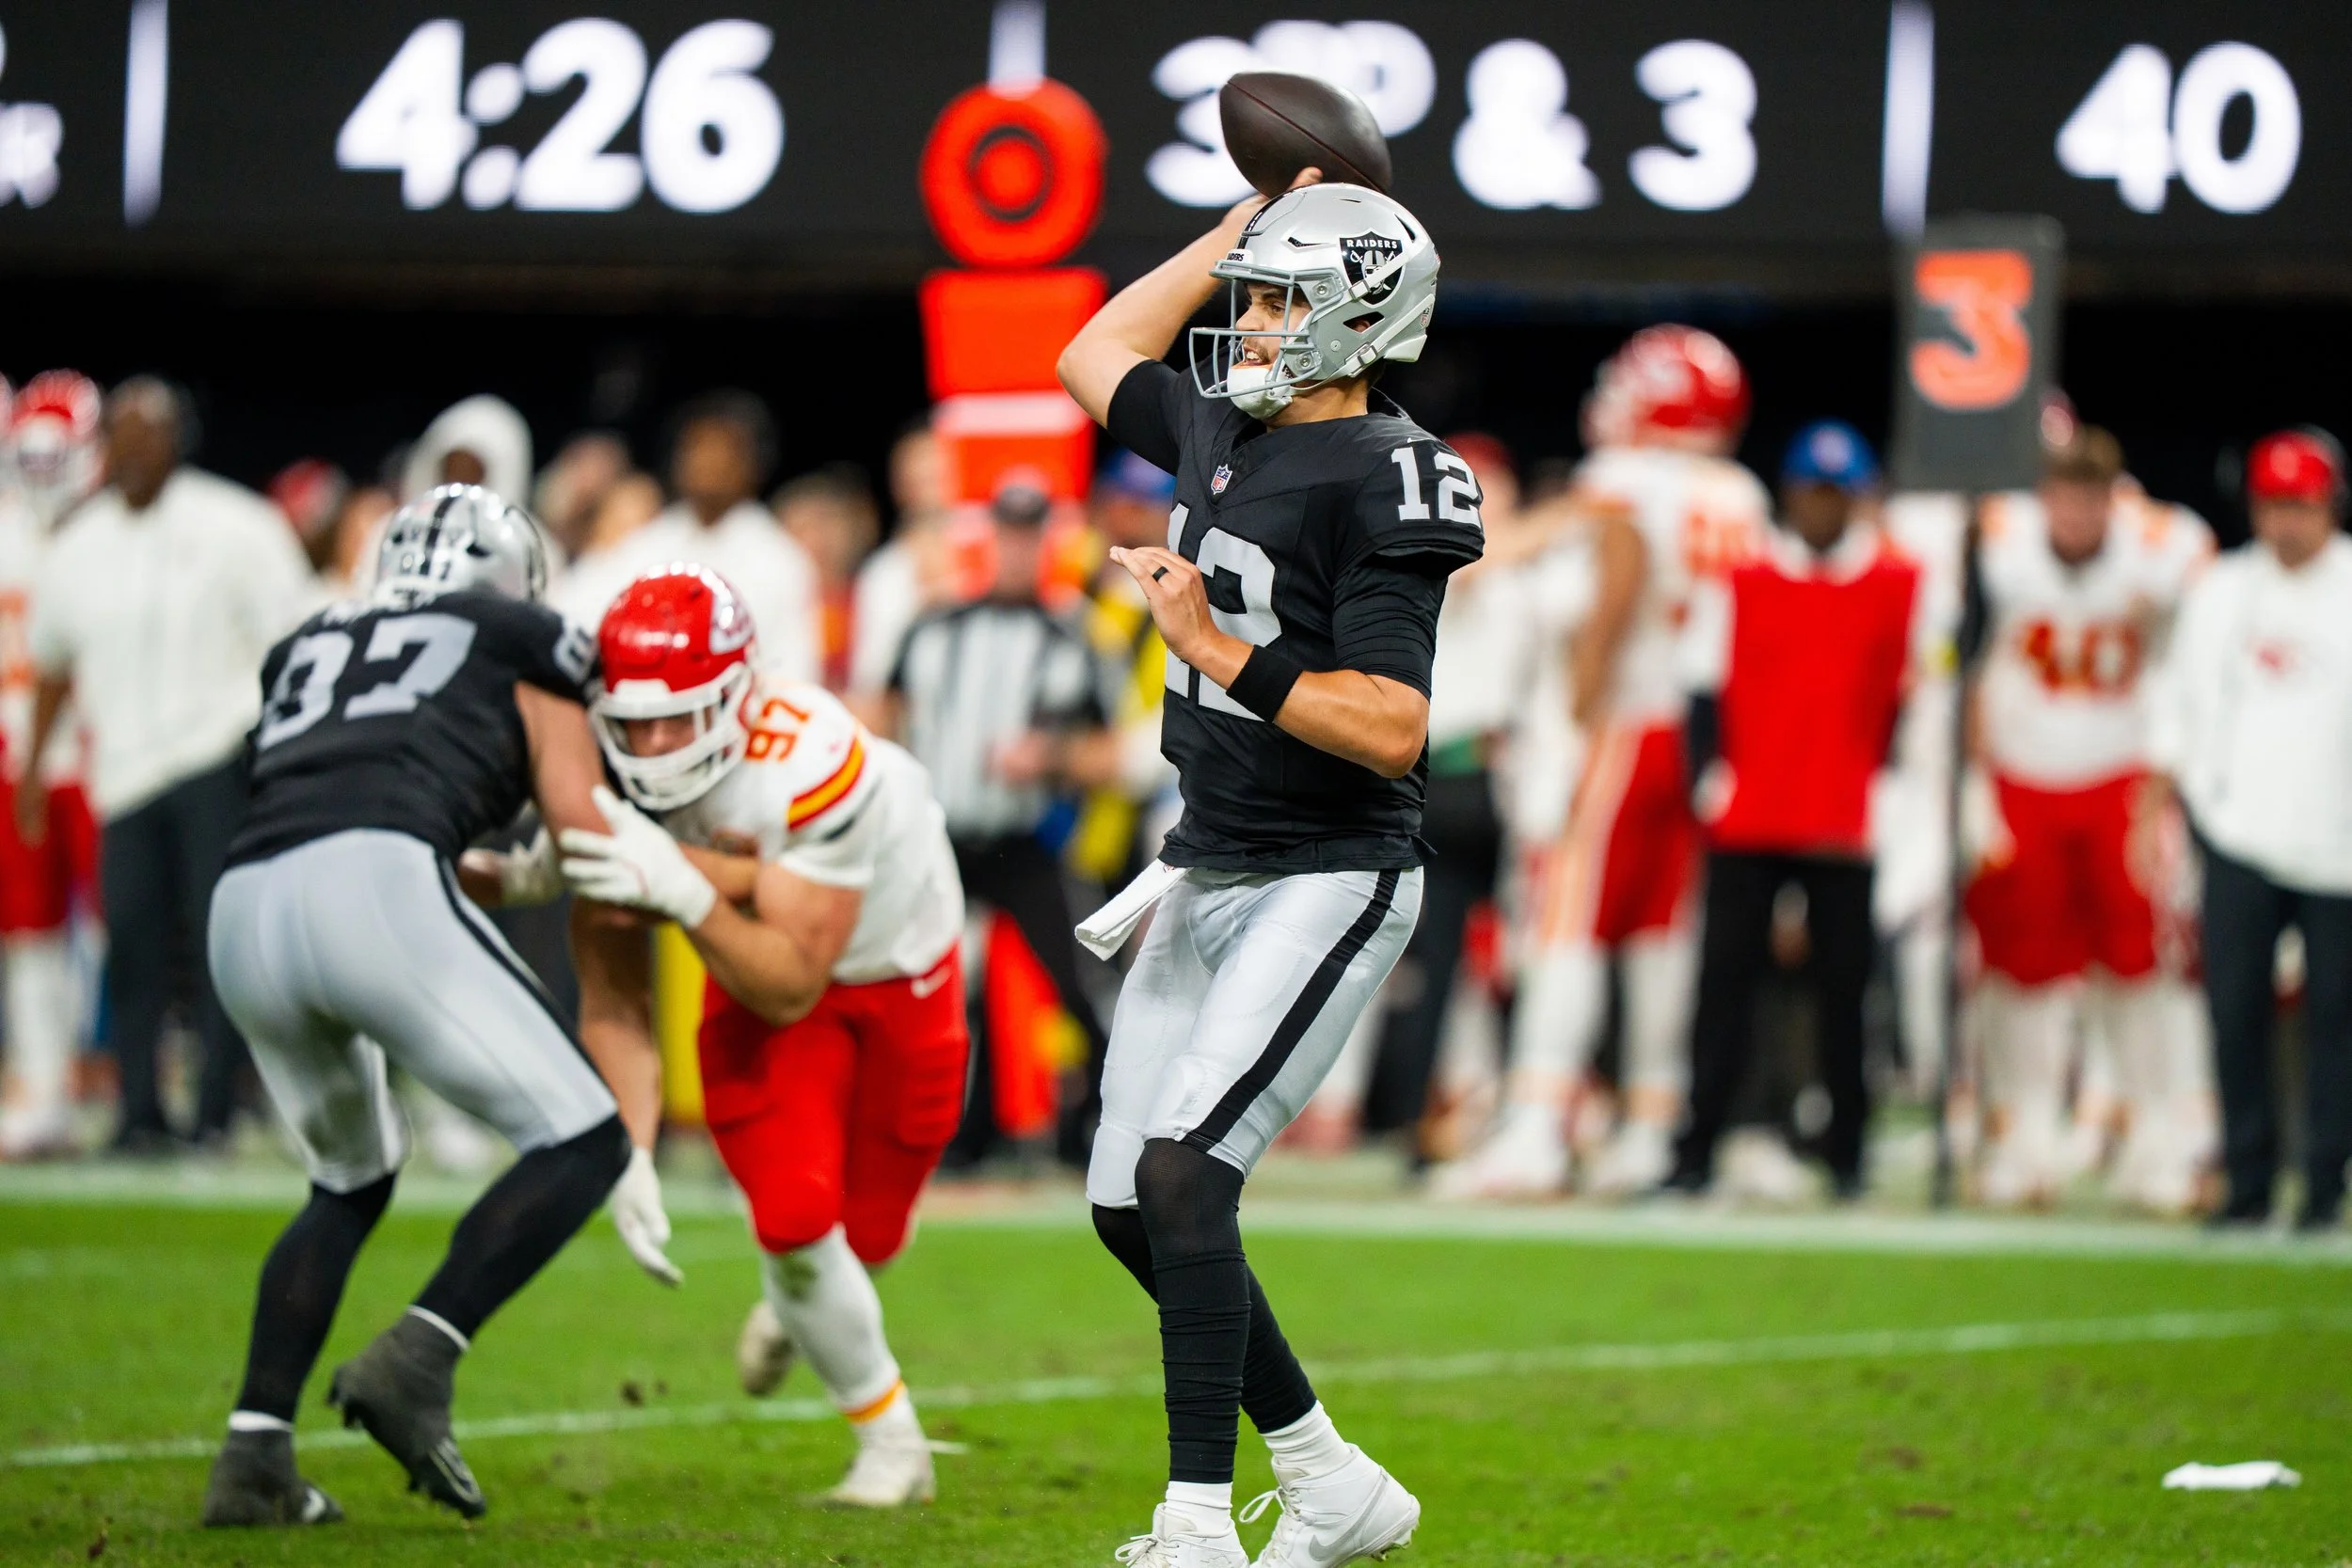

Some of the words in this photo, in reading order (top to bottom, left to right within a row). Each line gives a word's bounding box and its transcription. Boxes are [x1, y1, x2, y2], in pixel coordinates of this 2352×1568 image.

[336, 17, 785, 213] 4:26
[1454, 38, 1600, 210] &
[1628, 39, 1757, 211] 3
[2055, 41, 2302, 214] 40
[1346, 239, 1398, 249] RAIDERS
[1911, 248, 2032, 410] 3
[1390, 447, 1482, 529] 12
[744, 697, 813, 763] 97
